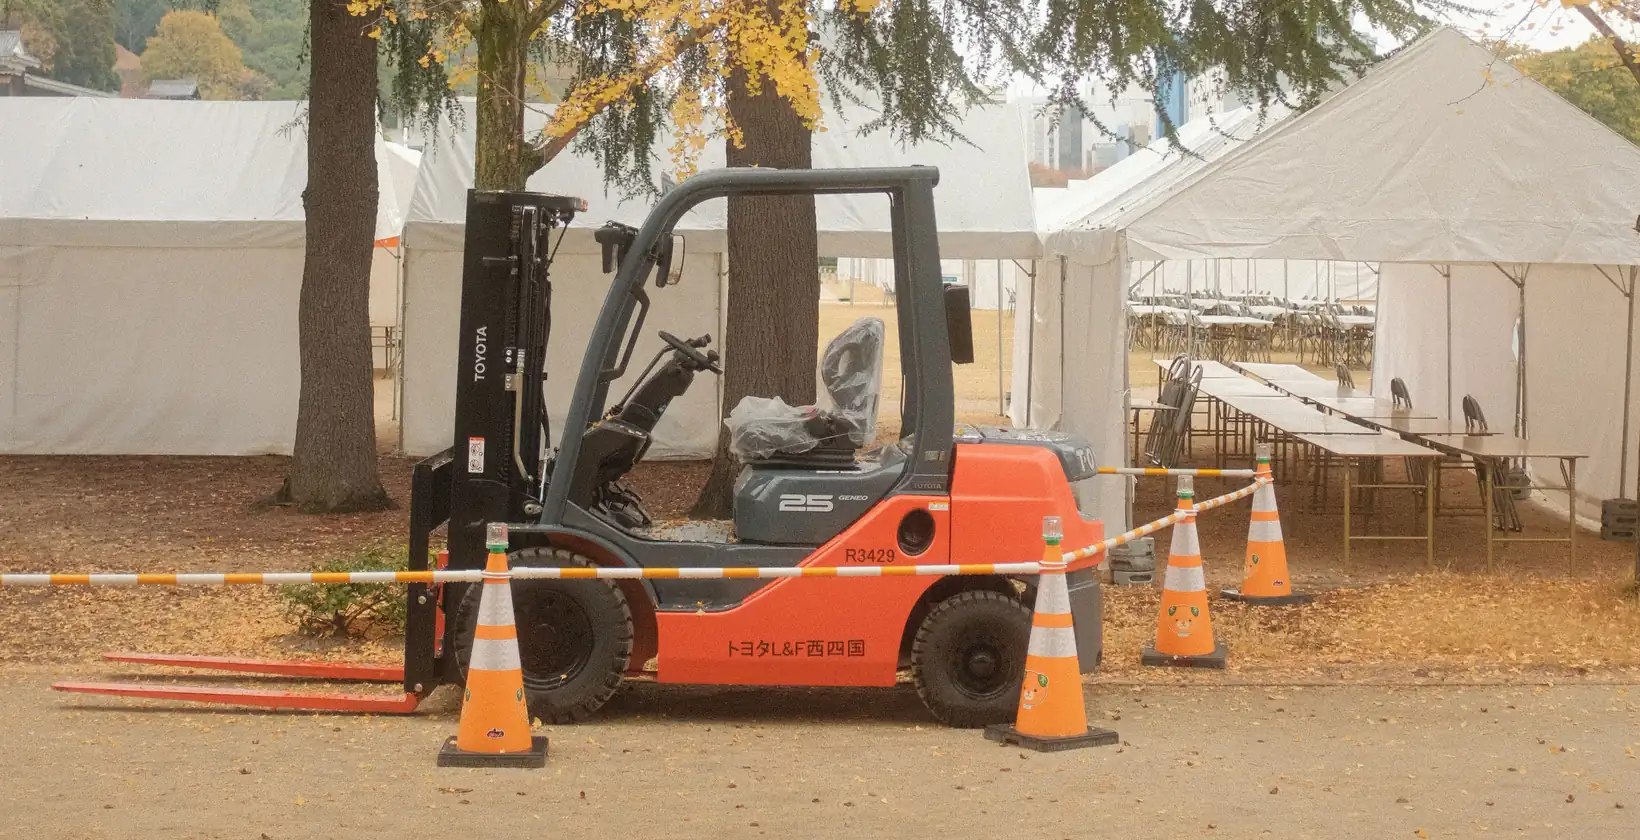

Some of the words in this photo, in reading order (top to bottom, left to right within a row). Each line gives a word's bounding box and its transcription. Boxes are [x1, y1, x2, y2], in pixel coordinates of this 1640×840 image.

[474, 326, 488, 382] TOYOTA
[779, 494, 834, 512] 25
[845, 548, 895, 563] R3429
[728, 639, 865, 657] トヨタL&F西四国
